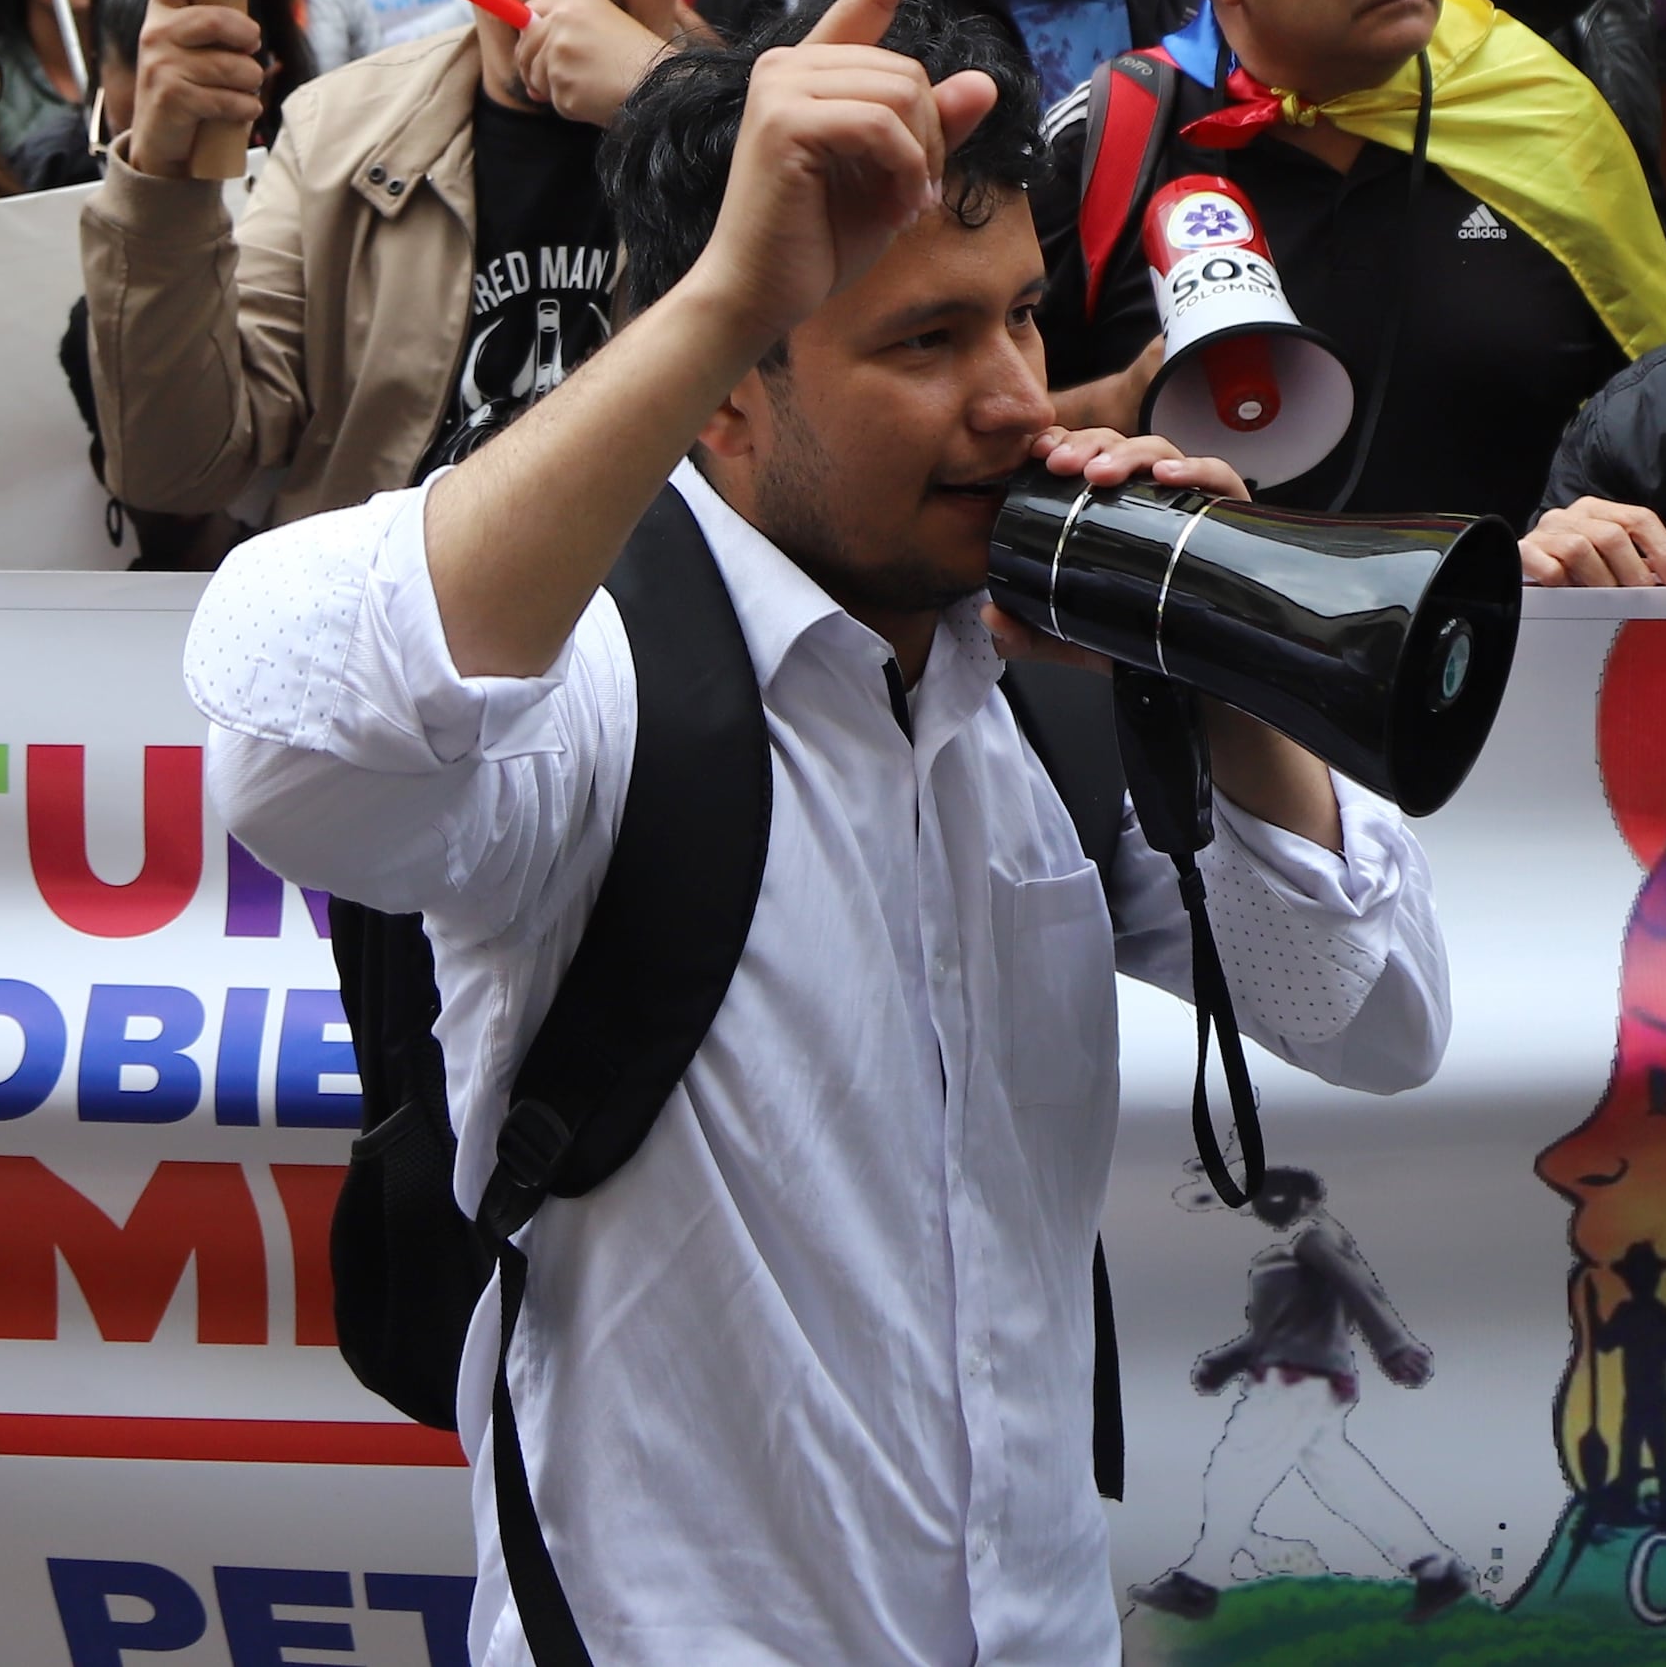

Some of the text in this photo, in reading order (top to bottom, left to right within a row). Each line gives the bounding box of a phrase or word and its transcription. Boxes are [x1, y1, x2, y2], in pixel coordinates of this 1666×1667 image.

[1458, 222, 1507, 240] adidas
[1173, 258, 1277, 307] SOS
[1176, 283, 1282, 318] COLOMBIA
